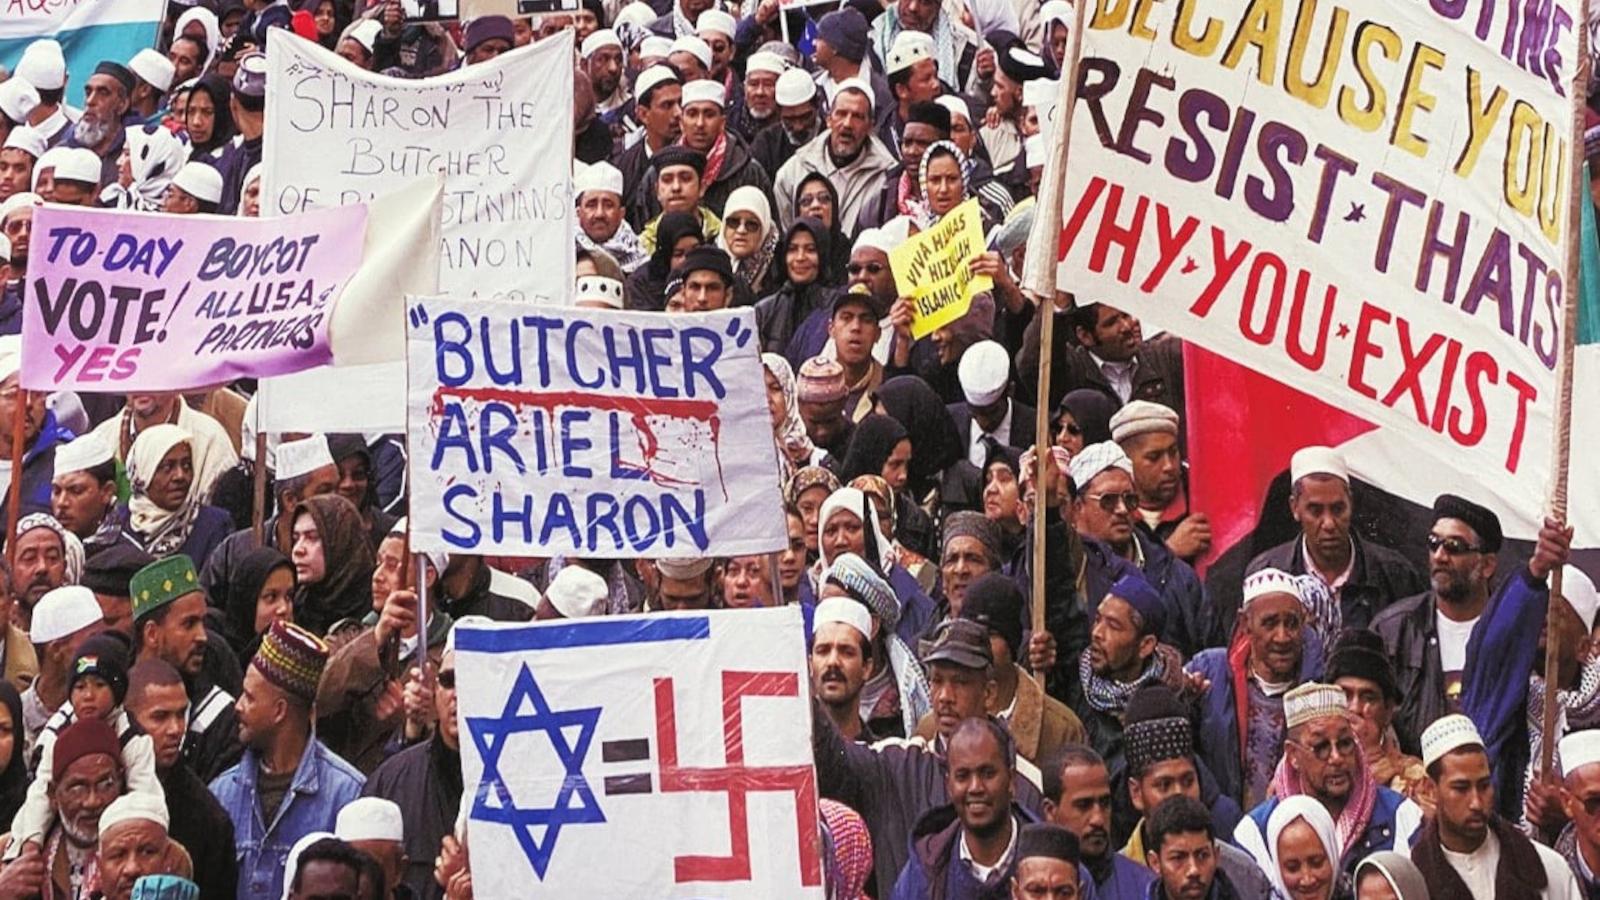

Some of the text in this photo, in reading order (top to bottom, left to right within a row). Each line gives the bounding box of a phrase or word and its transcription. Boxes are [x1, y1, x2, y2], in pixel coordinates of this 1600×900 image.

[290, 75, 534, 132] SHARON THE
[1087, 0, 1567, 246] CAUSE YOU
[340, 137, 510, 176] BUTCHER
[278, 184, 320, 215] OF
[1074, 56, 1563, 371] RESIST THATS
[46, 226, 184, 279] TO-DAY
[196, 233, 320, 282] BOYCOT
[906, 241, 933, 288] VIVA
[34, 276, 191, 345] VOTE!
[195, 290, 244, 320] ALL
[917, 281, 962, 317] ISLAMIC
[194, 312, 325, 356] PARTNERS
[409, 302, 751, 400] "BUTCHER"
[1189, 225, 1338, 372] YOU
[1347, 300, 1538, 475] EXIST
[53, 343, 142, 385] YES
[430, 402, 652, 482] ARIEL
[440, 483, 710, 551] SHARON
